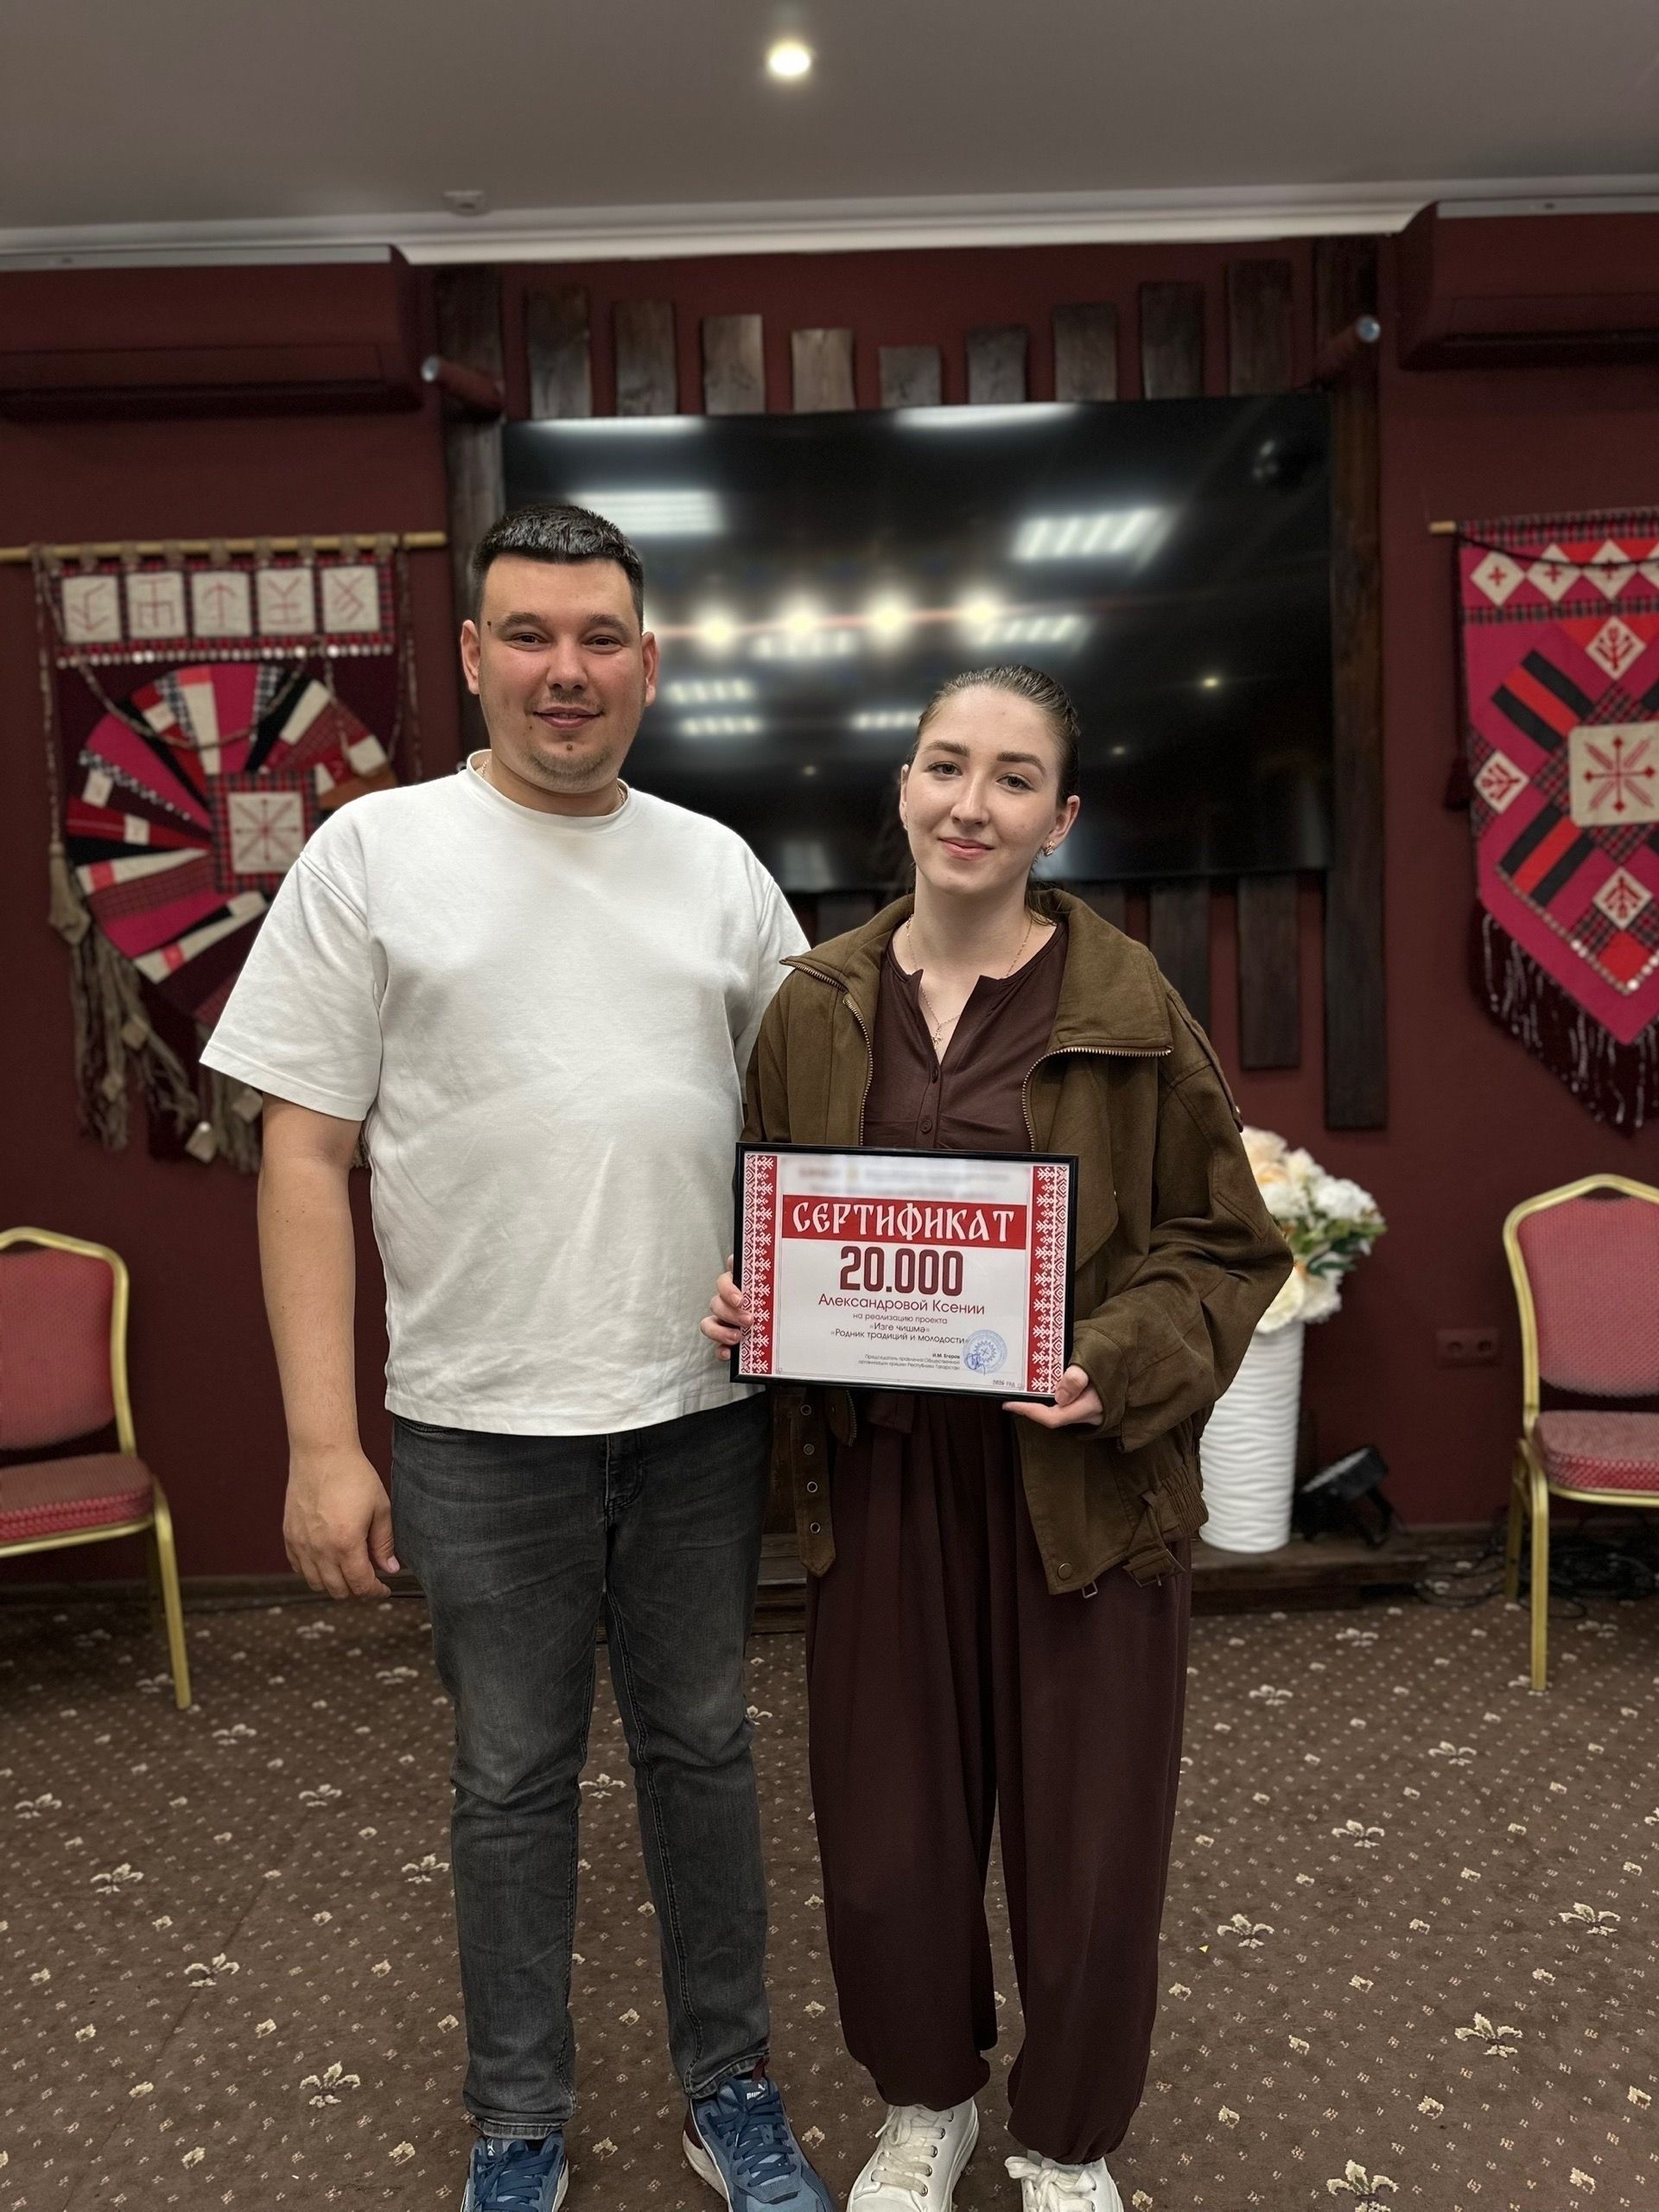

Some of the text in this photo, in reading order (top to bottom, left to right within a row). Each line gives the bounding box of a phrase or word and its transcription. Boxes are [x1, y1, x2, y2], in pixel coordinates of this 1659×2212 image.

[792, 1202, 1014, 1242] СЕРТИФИКАТ
[840, 1245, 963, 1297] 20.000
[818, 1294, 985, 1314] Александровой Ксении
[865, 1313, 913, 1322] реализацию
[868, 1332, 907, 1340] традиций
